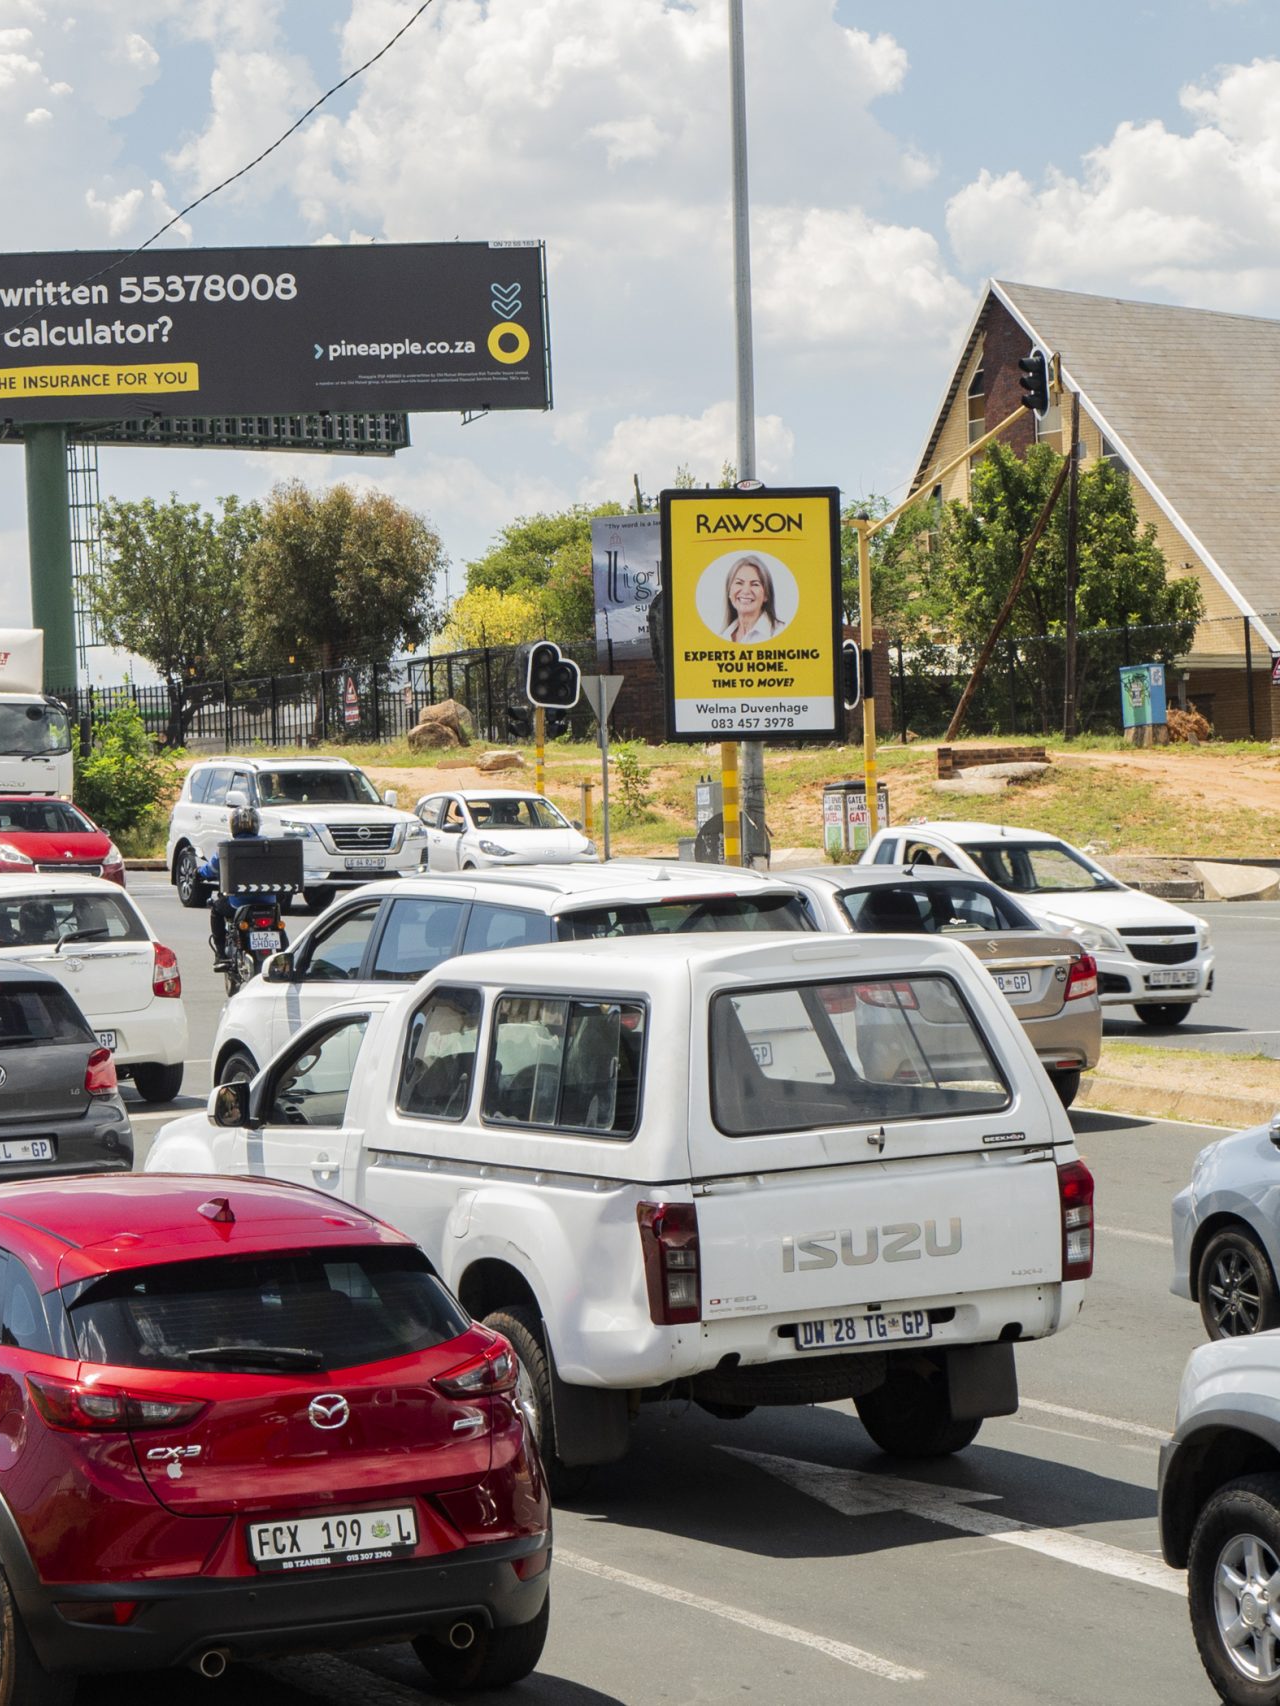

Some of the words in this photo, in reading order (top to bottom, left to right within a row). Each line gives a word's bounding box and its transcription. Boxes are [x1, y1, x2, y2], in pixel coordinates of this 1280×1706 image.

[0, 279, 109, 307] written
[120, 272, 298, 304] 55378008
[4, 315, 173, 347] calculator?
[328, 338, 476, 361] pineapple.co.za
[23, 374, 114, 389] INSURANCE
[116, 372, 147, 385] FOR
[154, 371, 188, 384] YOU
[696, 513, 803, 534] RAWSON
[684, 650, 736, 661] EXPERTS
[739, 650, 754, 660] AT
[757, 649, 820, 660] BRINGING
[717, 663, 743, 673] YOU
[747, 662, 788, 673] HOME.
[712, 679, 737, 688] TIME
[739, 679, 754, 688] TO
[757, 678, 795, 687] MOVE?
[696, 703, 737, 714] Welma
[740, 702, 809, 715] Duvenhage
[711, 719, 734, 729] 083
[737, 718, 760, 728] 457
[764, 718, 794, 728] 3978
[848, 796, 862, 804] GATE
[1013, 976, 1027, 990] GP
[100, 1033, 113, 1046] GP
[31, 1141, 48, 1157] GP
[782, 1216, 963, 1273] ISUZU
[803, 1321, 825, 1345] DW
[833, 1318, 856, 1342] 28
[863, 1315, 887, 1339] TG
[902, 1312, 924, 1335] GP
[147, 1444, 202, 1460] CX-3
[257, 1525, 301, 1557] FCX
[321, 1519, 362, 1550] 199
[396, 1514, 411, 1542] L
[282, 1560, 294, 1569] BB
[295, 1557, 331, 1568] TZANEEN
[346, 1554, 359, 1562] 015
[360, 1552, 373, 1560] 307
